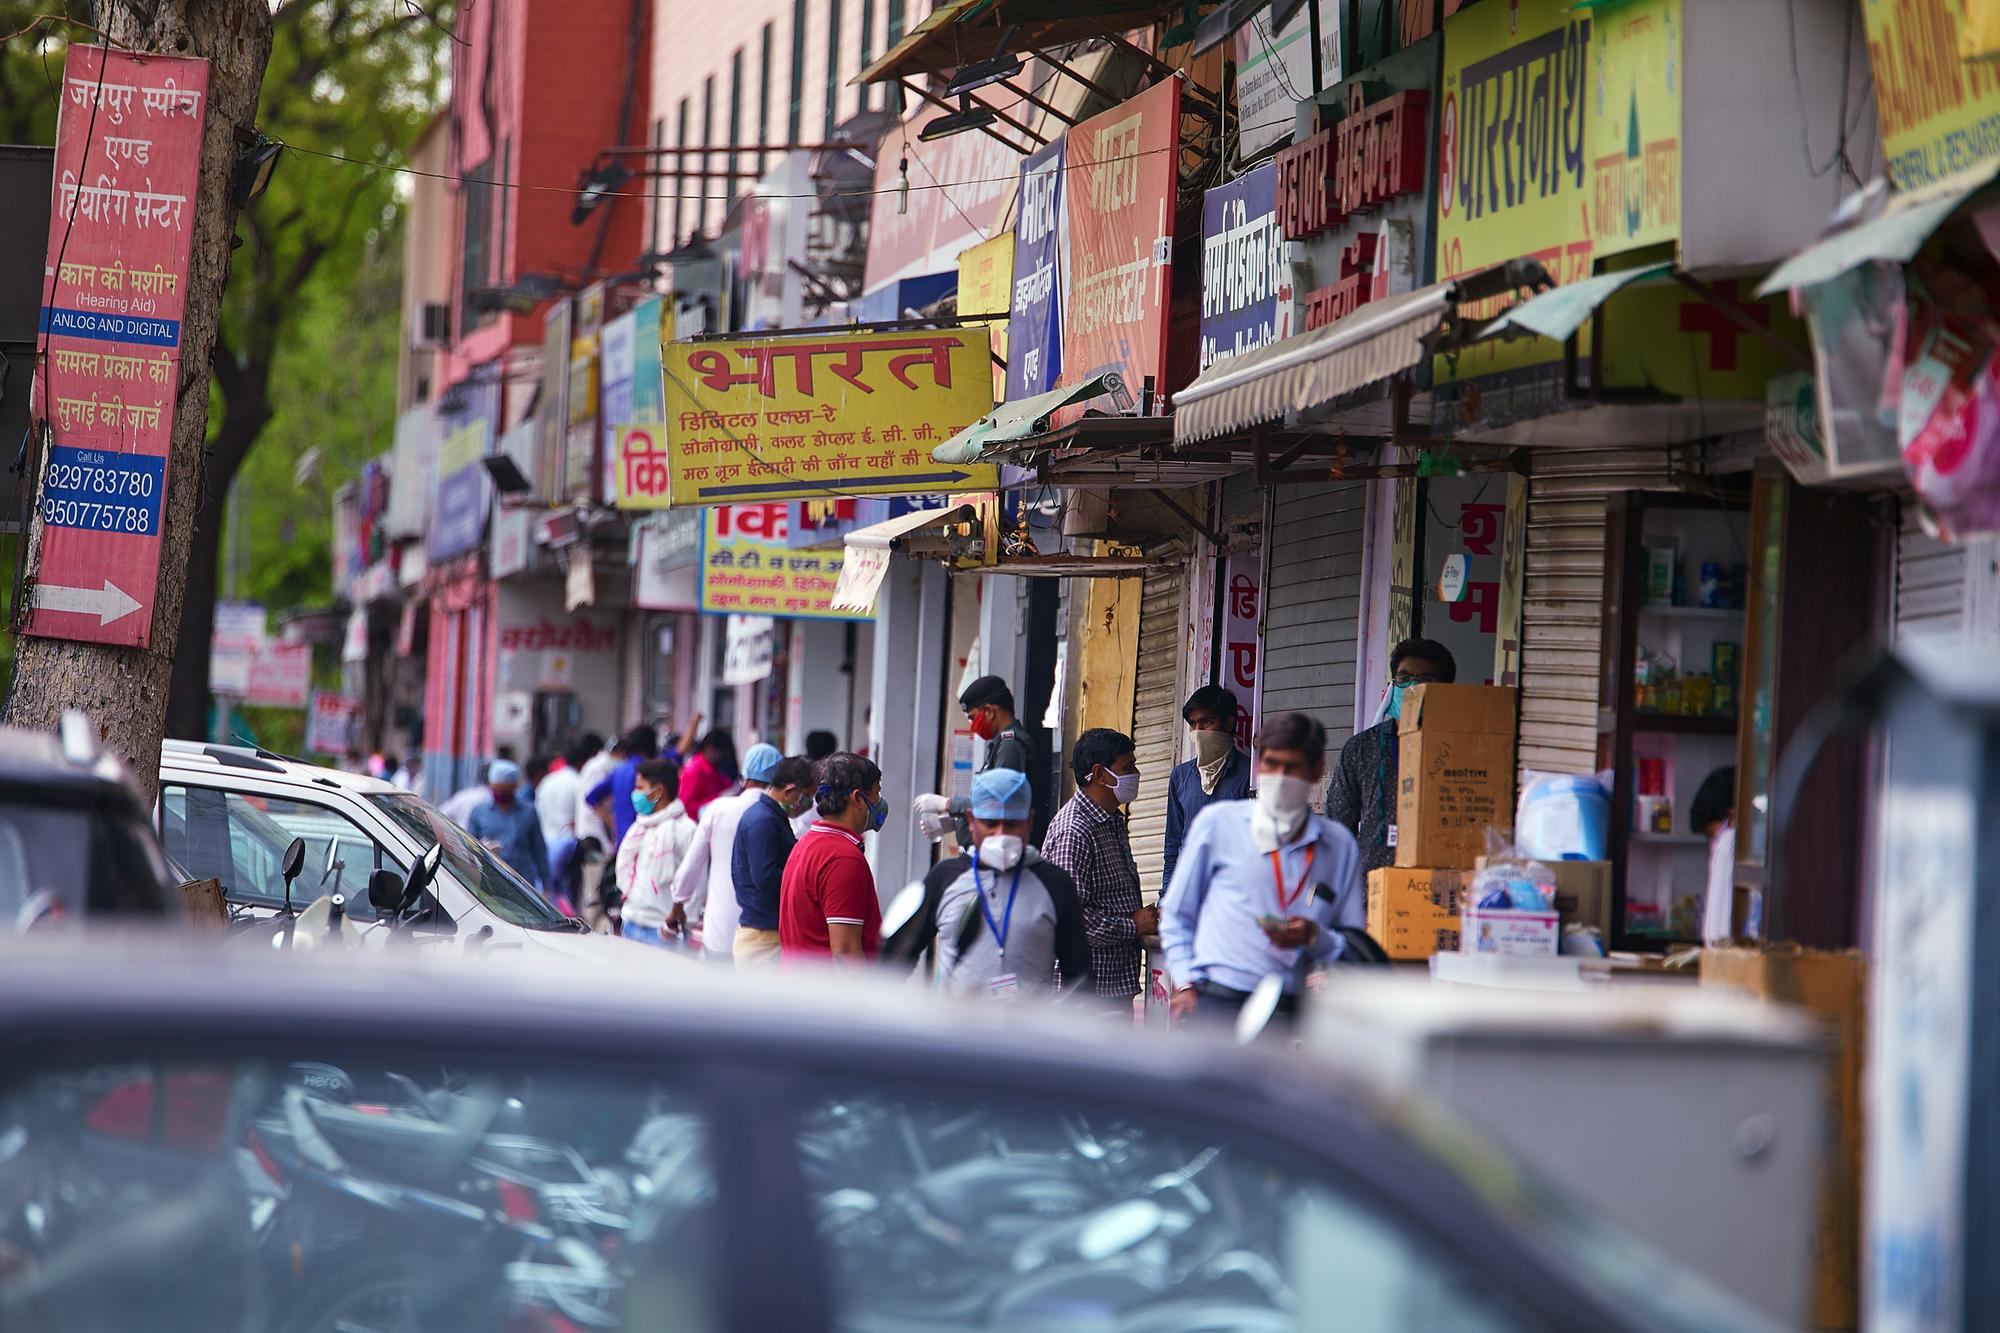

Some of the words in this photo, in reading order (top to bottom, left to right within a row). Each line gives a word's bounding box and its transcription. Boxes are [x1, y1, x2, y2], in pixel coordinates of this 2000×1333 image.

[68, 78, 137, 125] जयपुर
[142, 78, 202, 120] स्पीच
[1090, 111, 1143, 216] भारत
[134, 178, 187, 231] सेन्टर
[1021, 153, 1059, 245] भारत
[60, 262, 97, 288] कान
[101, 260, 126, 290] की
[131, 263, 178, 296] मशीन
[76, 292, 128, 312] (Hearing
[131, 297, 157, 315] Aid)
[53, 312, 96, 331] ANLOG
[98, 316, 124, 333] AND
[127, 319, 174, 338] DIGITAL
[55, 350, 100, 378] समस्त
[103, 351, 144, 380] प्रकार
[148, 352, 171, 384] की
[687, 336, 965, 399] भारत
[57, 391, 98, 432] सुनाई
[100, 394, 124, 424] की
[679, 410, 758, 433] डिजिटल
[77, 450, 91, 462] Call
[93, 453, 105, 464] Us
[771, 434, 806, 450] कलर
[813, 430, 857, 447] डोप्लर
[44, 462, 153, 498] 829783780
[683, 465, 709, 482] मल
[714, 463, 741, 484] मूत्र
[802, 455, 822, 473] की
[828, 451, 860, 471] जाँच
[866, 448, 896, 470] यहाँ
[902, 447, 921, 467] की
[1229, 573, 1259, 619] डि
